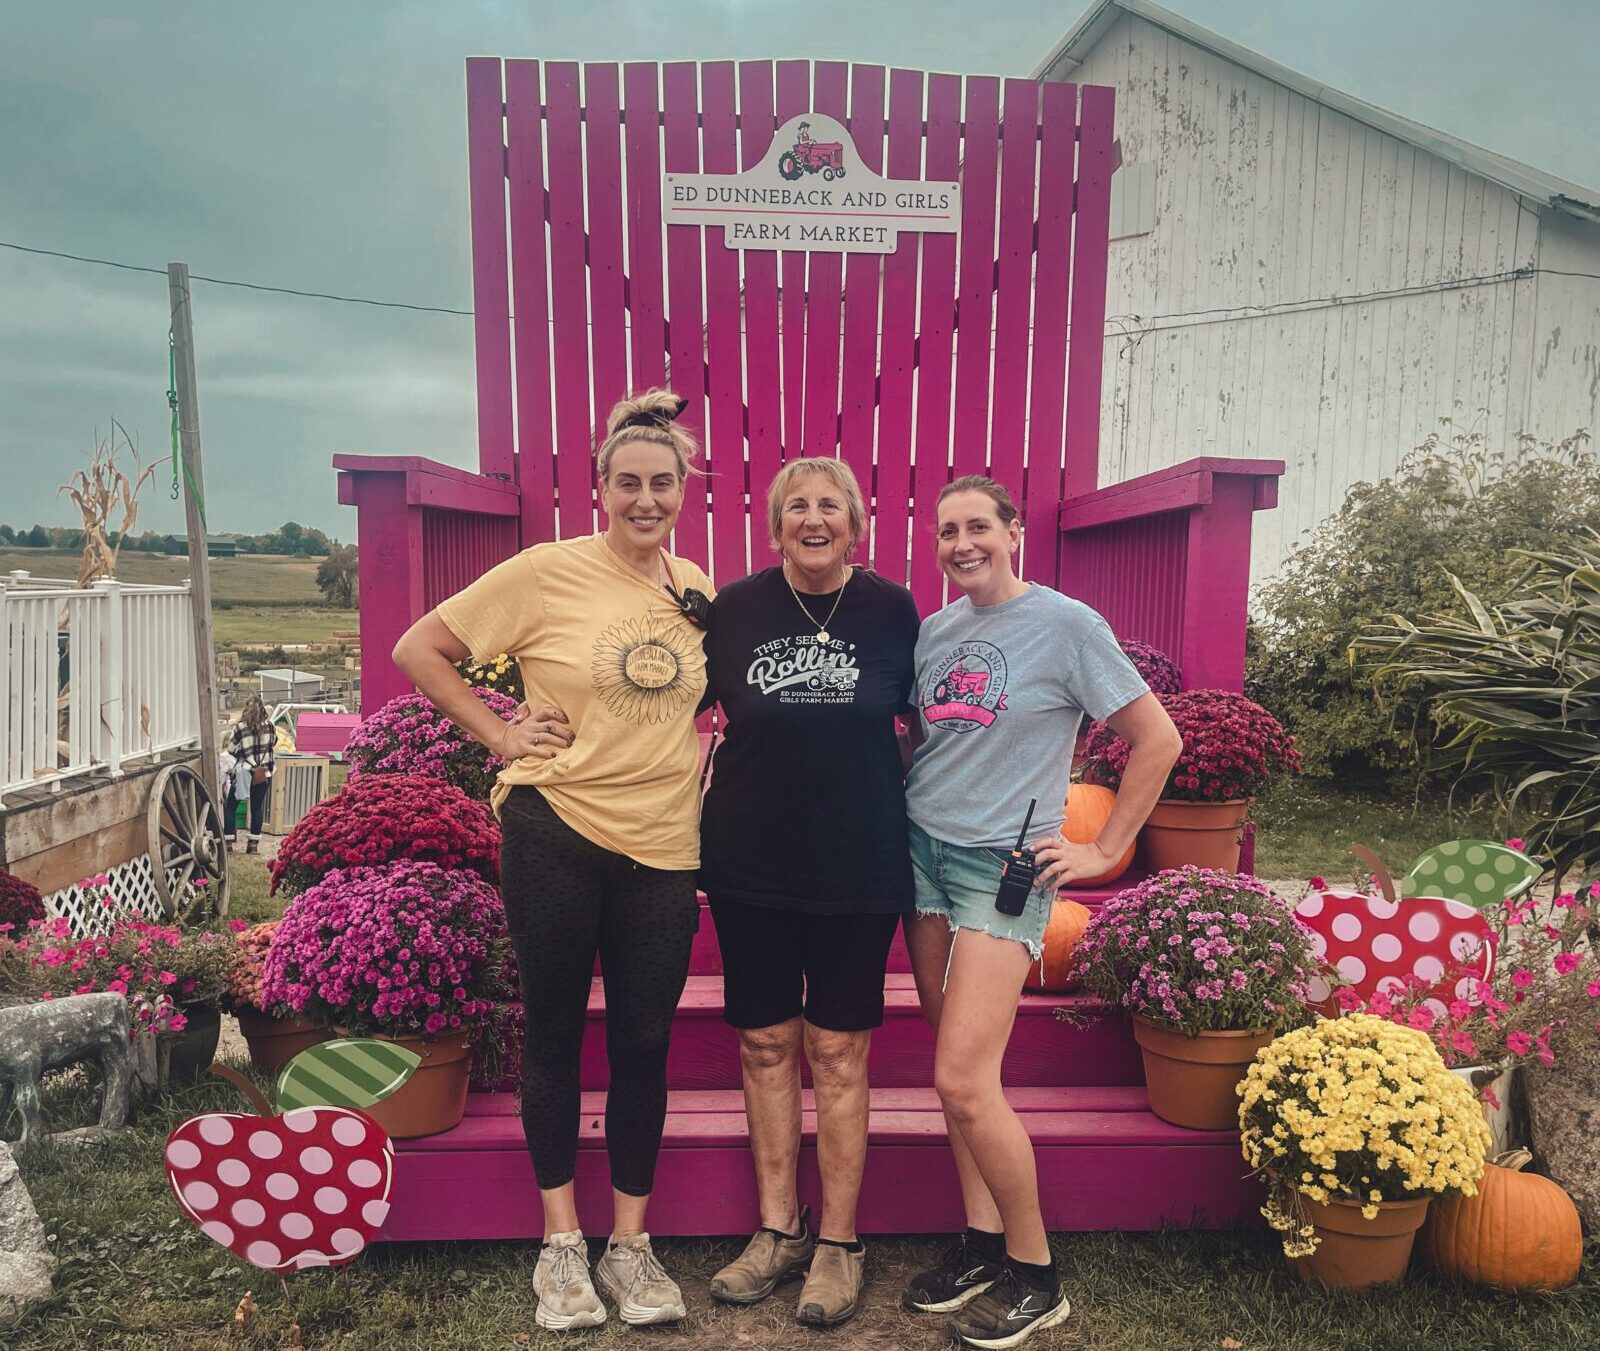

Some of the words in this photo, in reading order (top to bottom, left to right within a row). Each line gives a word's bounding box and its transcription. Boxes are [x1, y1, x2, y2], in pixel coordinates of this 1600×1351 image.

[673, 186, 698, 202] ED
[706, 187, 833, 206] DUNNEBACK
[842, 192, 887, 208] AND
[895, 193, 950, 210] GIRLS
[734, 223, 791, 241] FARM
[800, 225, 888, 243] MARKET
[753, 636, 792, 657] THEY
[795, 635, 818, 645] SEE
[932, 644, 985, 685] DUNNEBACK
[985, 651, 1002, 672] AND
[985, 676, 1003, 706] GIRLS
